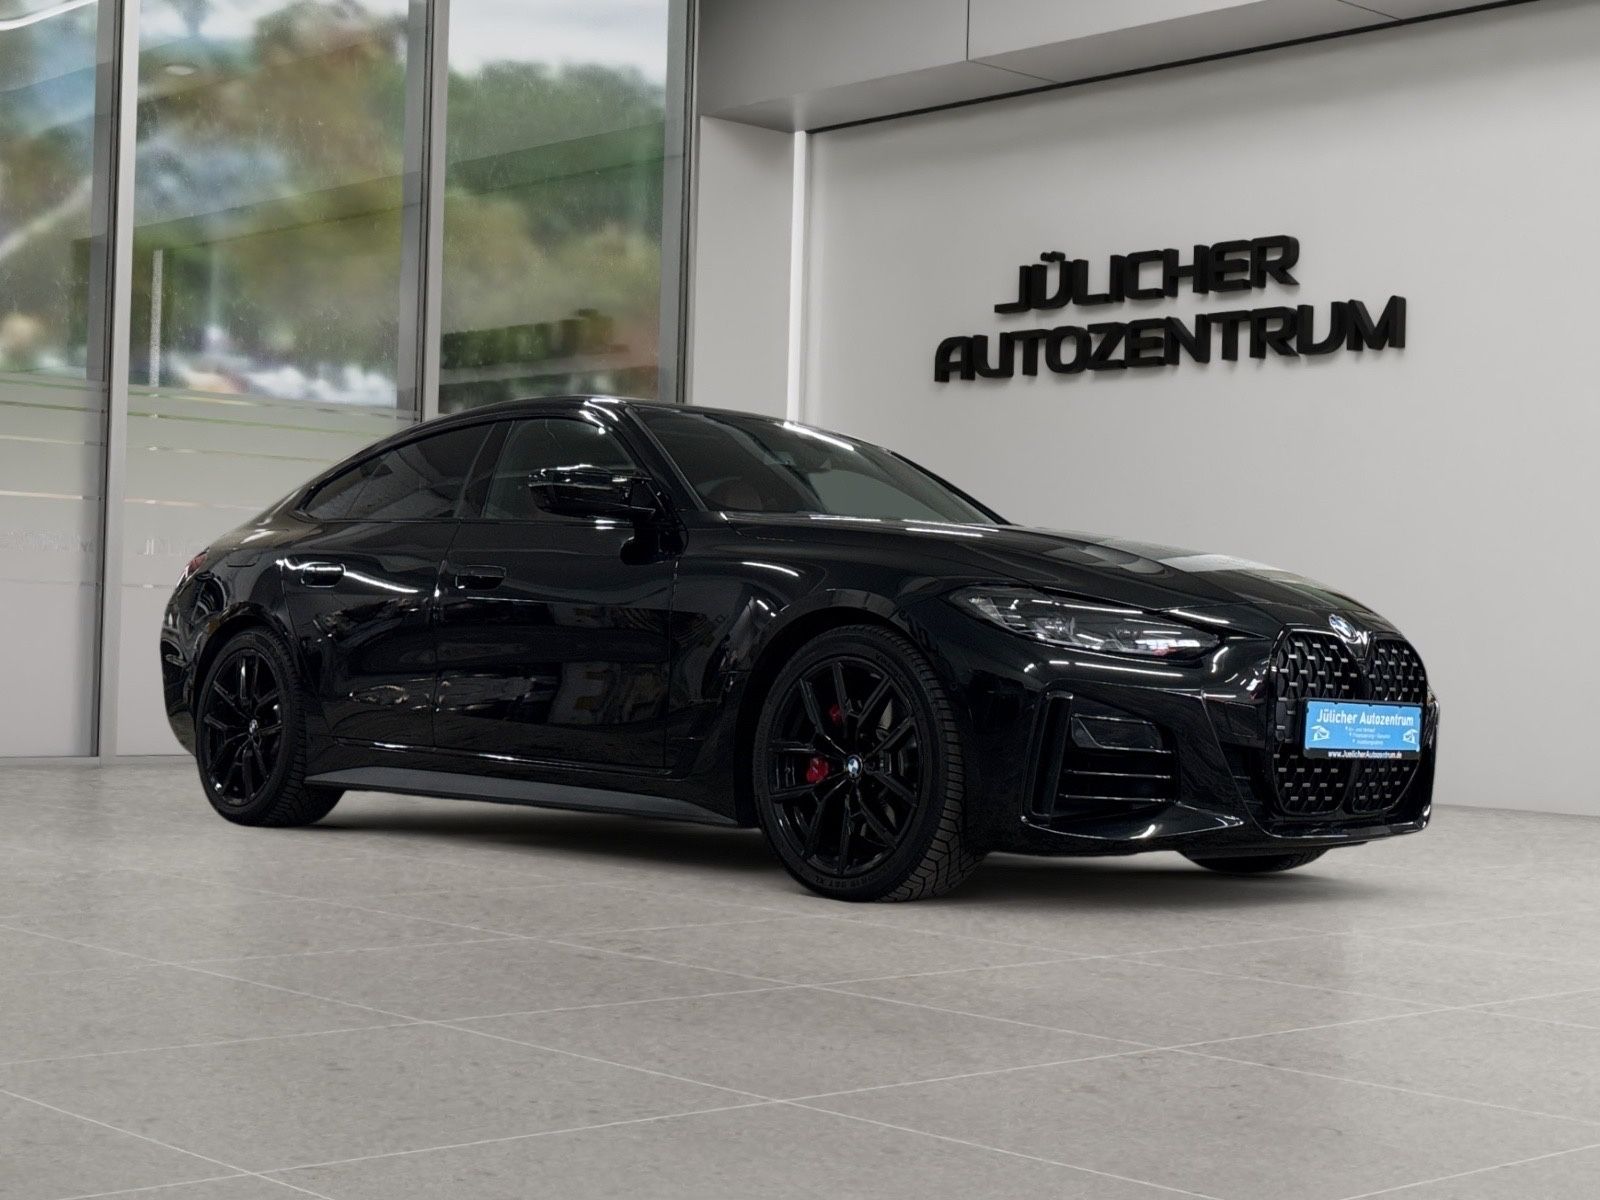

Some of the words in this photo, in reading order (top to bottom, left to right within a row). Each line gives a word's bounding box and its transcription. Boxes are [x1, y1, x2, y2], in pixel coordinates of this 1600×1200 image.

[994, 234, 1300, 314] JÜLICHER
[934, 295, 1407, 383] AUTOZENTRUM
[1316, 709, 1357, 724] Jülicher
[1359, 711, 1414, 727] Autozentrum
